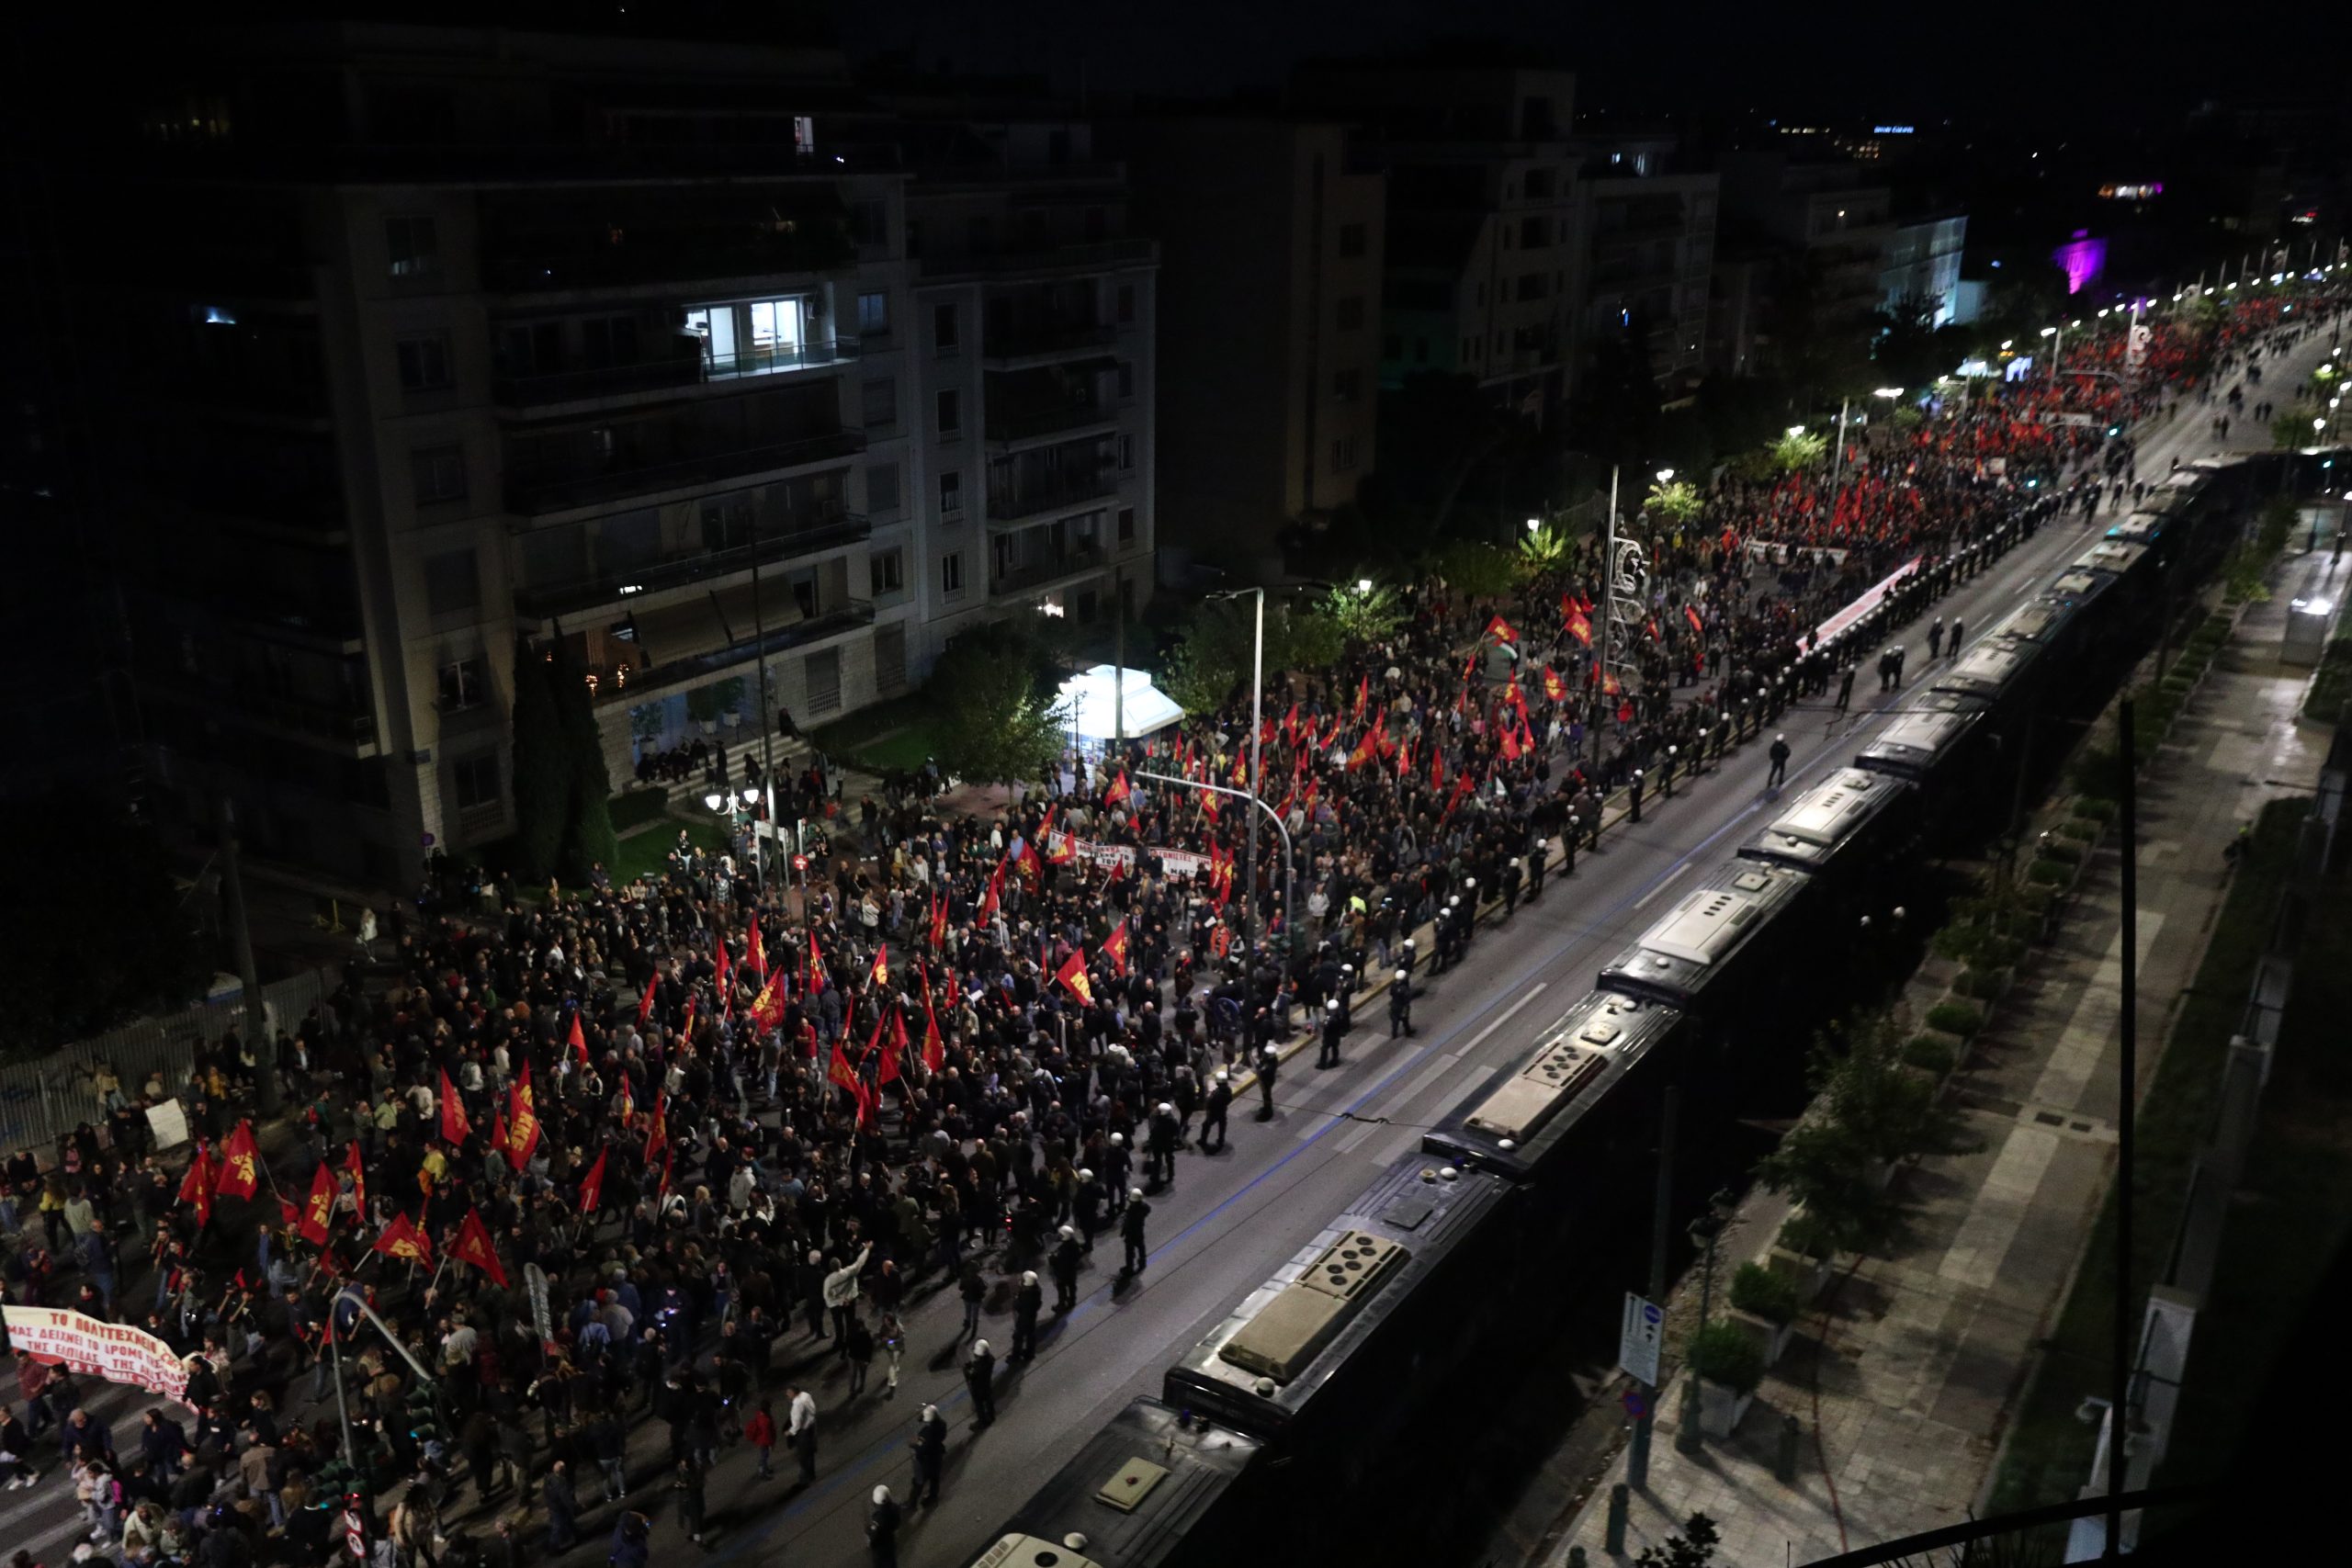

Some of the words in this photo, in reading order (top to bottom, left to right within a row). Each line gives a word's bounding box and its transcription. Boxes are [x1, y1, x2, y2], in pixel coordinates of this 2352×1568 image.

[40, 1328, 83, 1347] ΔΕΙΧΝΕΙ
[87, 1338, 98, 1351] ΤΟ
[50, 1313, 68, 1326] ΤΟ
[75, 1317, 156, 1354] ΠΟΛΥΤΕΧΝΕΙΟ
[28, 1341, 49, 1353] ΤΗΣ
[55, 1343, 98, 1364] ΕΛΠΙΔΑΣ
[113, 1359, 134, 1371] ΤΗΣ
